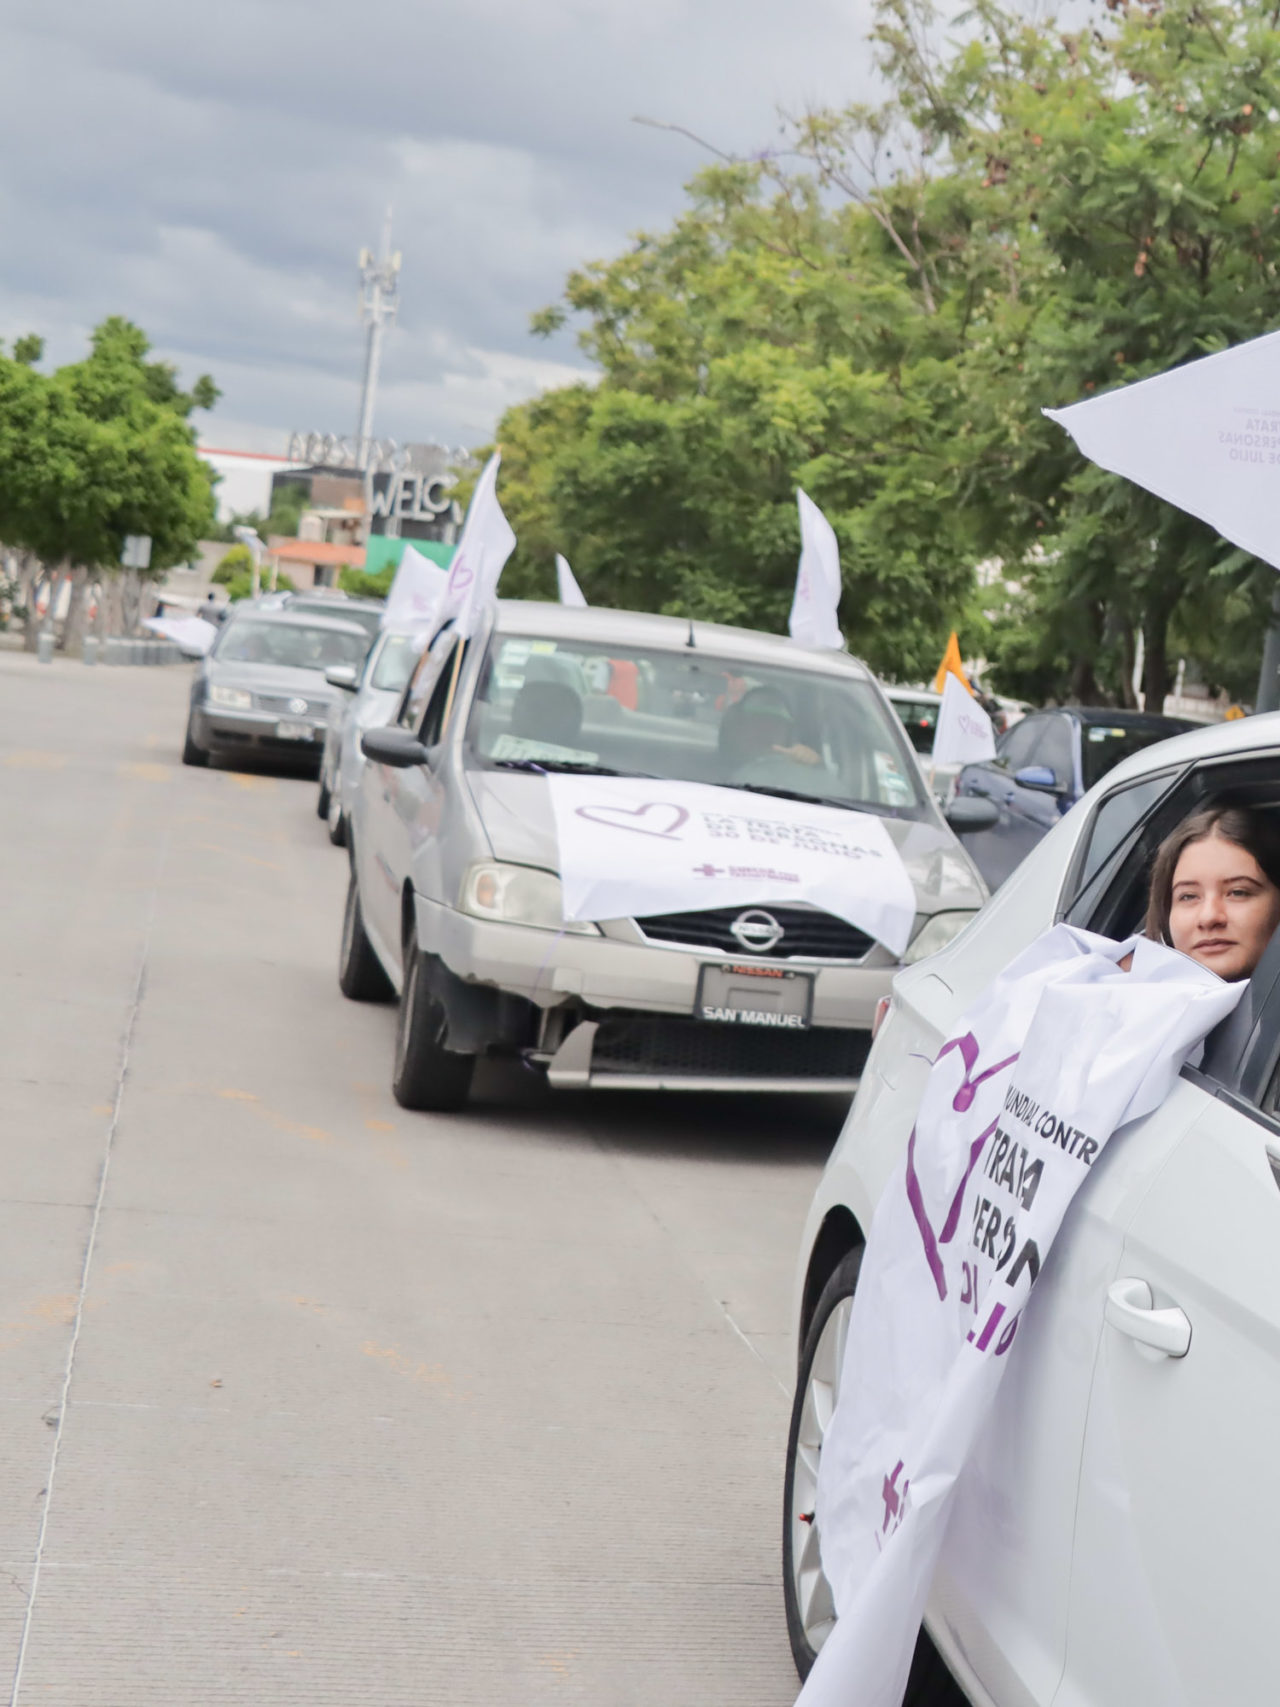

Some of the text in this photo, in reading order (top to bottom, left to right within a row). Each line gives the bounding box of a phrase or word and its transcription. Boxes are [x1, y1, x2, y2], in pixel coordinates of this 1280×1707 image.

[732, 965, 784, 978] NISSAN
[702, 1006, 805, 1029] SAN MANUEL
[984, 1127, 1045, 1212] TRATA
